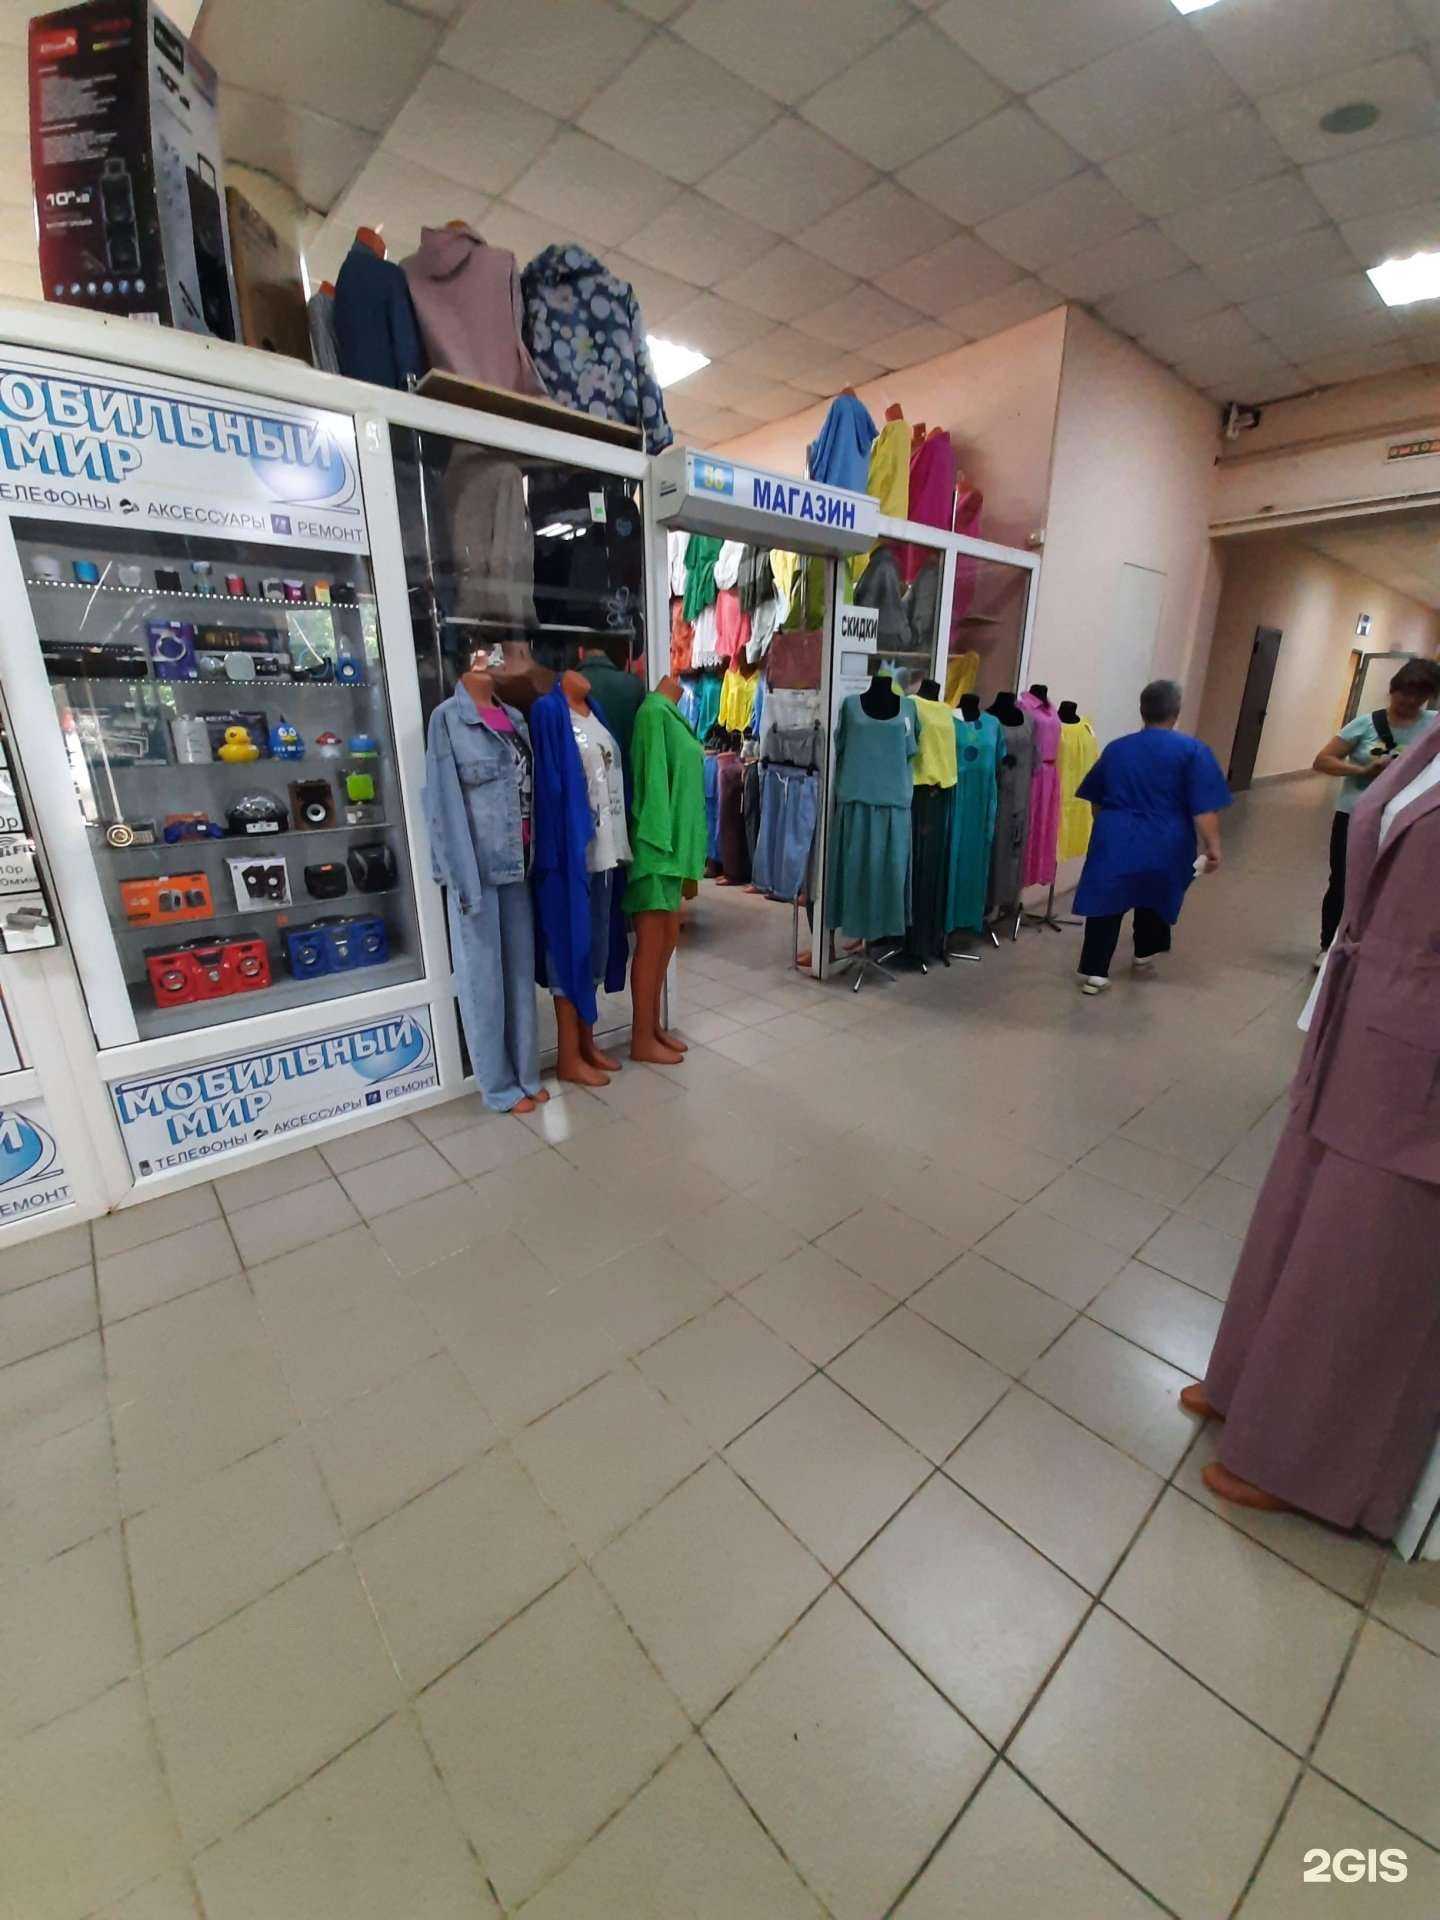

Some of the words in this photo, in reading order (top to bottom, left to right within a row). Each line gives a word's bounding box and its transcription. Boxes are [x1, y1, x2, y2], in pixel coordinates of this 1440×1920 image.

[0, 424, 143, 483] МИР
[147, 501, 266, 530] АКСЕССУАРЫ
[297, 520, 364, 542] РЕМОНТ
[752, 477, 856, 530] МАГАЗИН
[841, 615, 878, 642] СКИДКИ
[115, 1016, 415, 1125] МОБИЛЬНЫЙ
[155, 1134, 249, 1171] ТЕЛЕФОНЫ
[273, 1099, 363, 1135] АКСЕССУАРЫ
[385, 1076, 437, 1099] РЕМОНТ
[166, 1089, 272, 1146] МИР
[0, 1184, 72, 1217] ЕМОНТ
